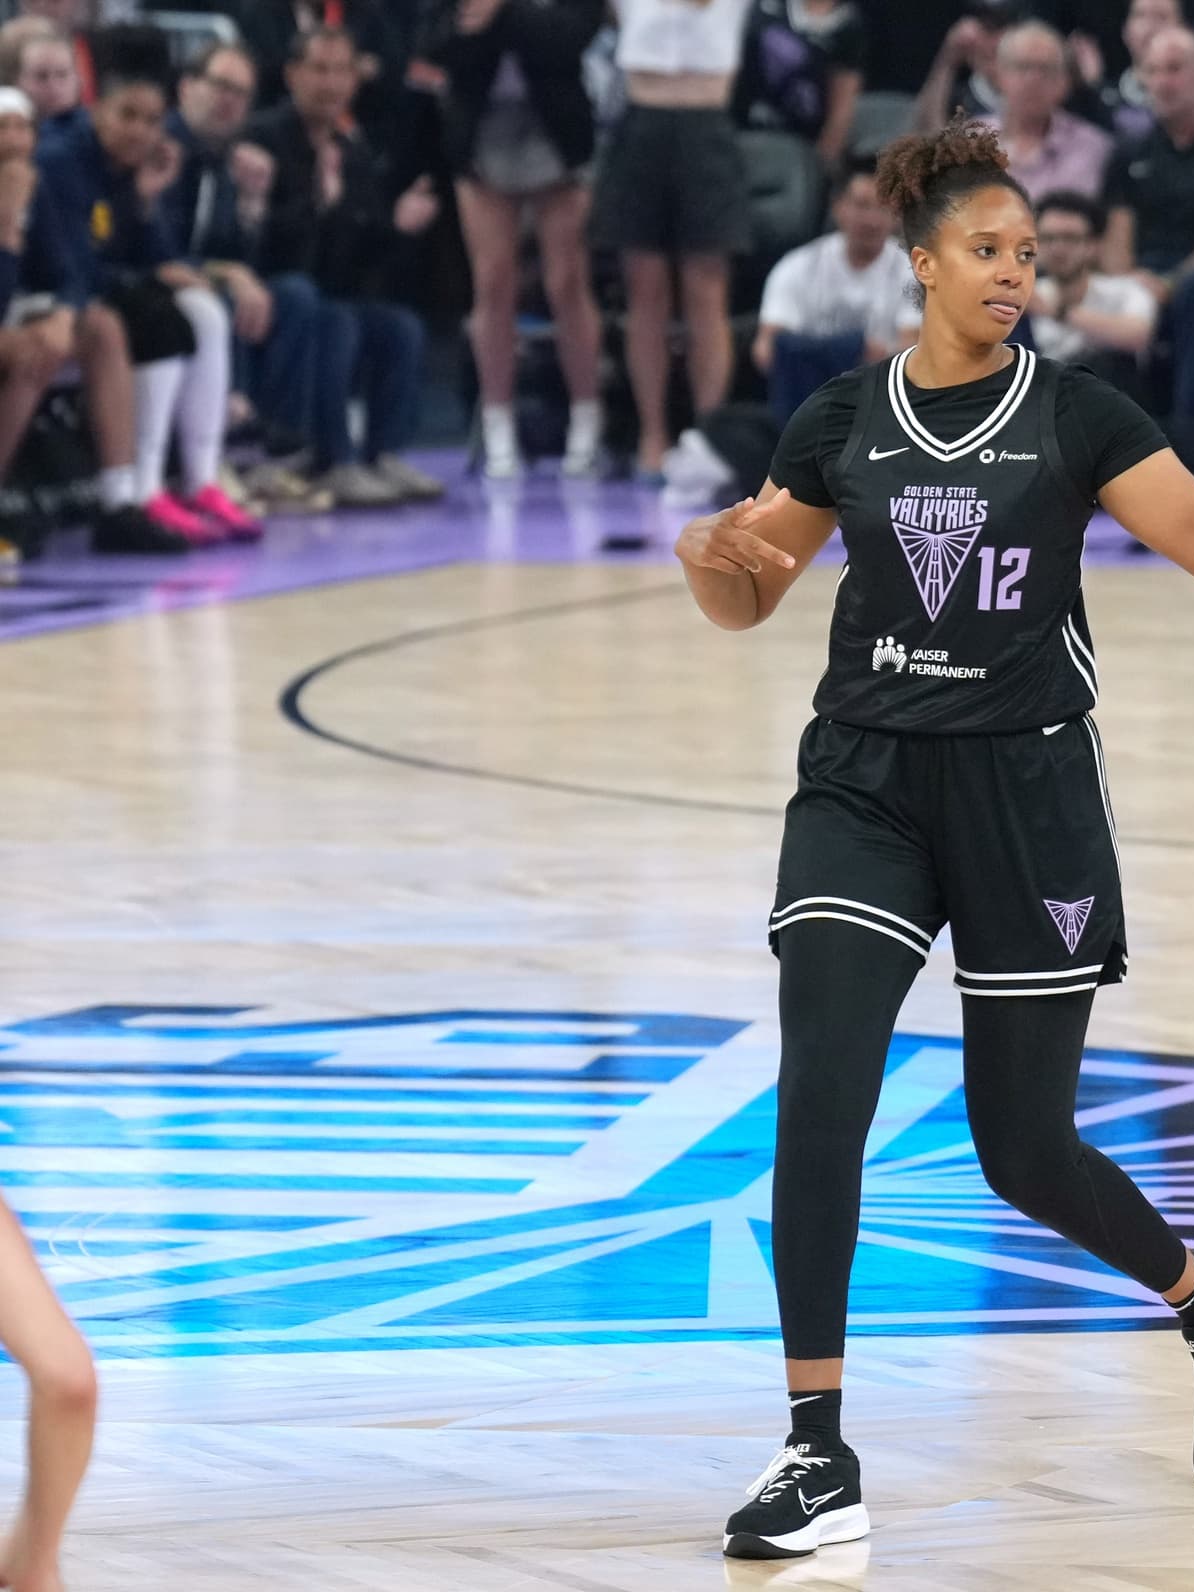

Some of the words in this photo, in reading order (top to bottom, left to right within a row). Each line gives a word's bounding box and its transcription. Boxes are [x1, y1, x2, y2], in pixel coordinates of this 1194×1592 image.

[998, 450, 1038, 462] freedom
[903, 485, 943, 498] GOLDEN
[945, 487, 977, 498] STATE
[889, 497, 989, 532] VALKYRIES
[977, 546, 1031, 611] 12
[910, 648, 949, 662] KAISER
[909, 663, 987, 679] PERMANENTE
